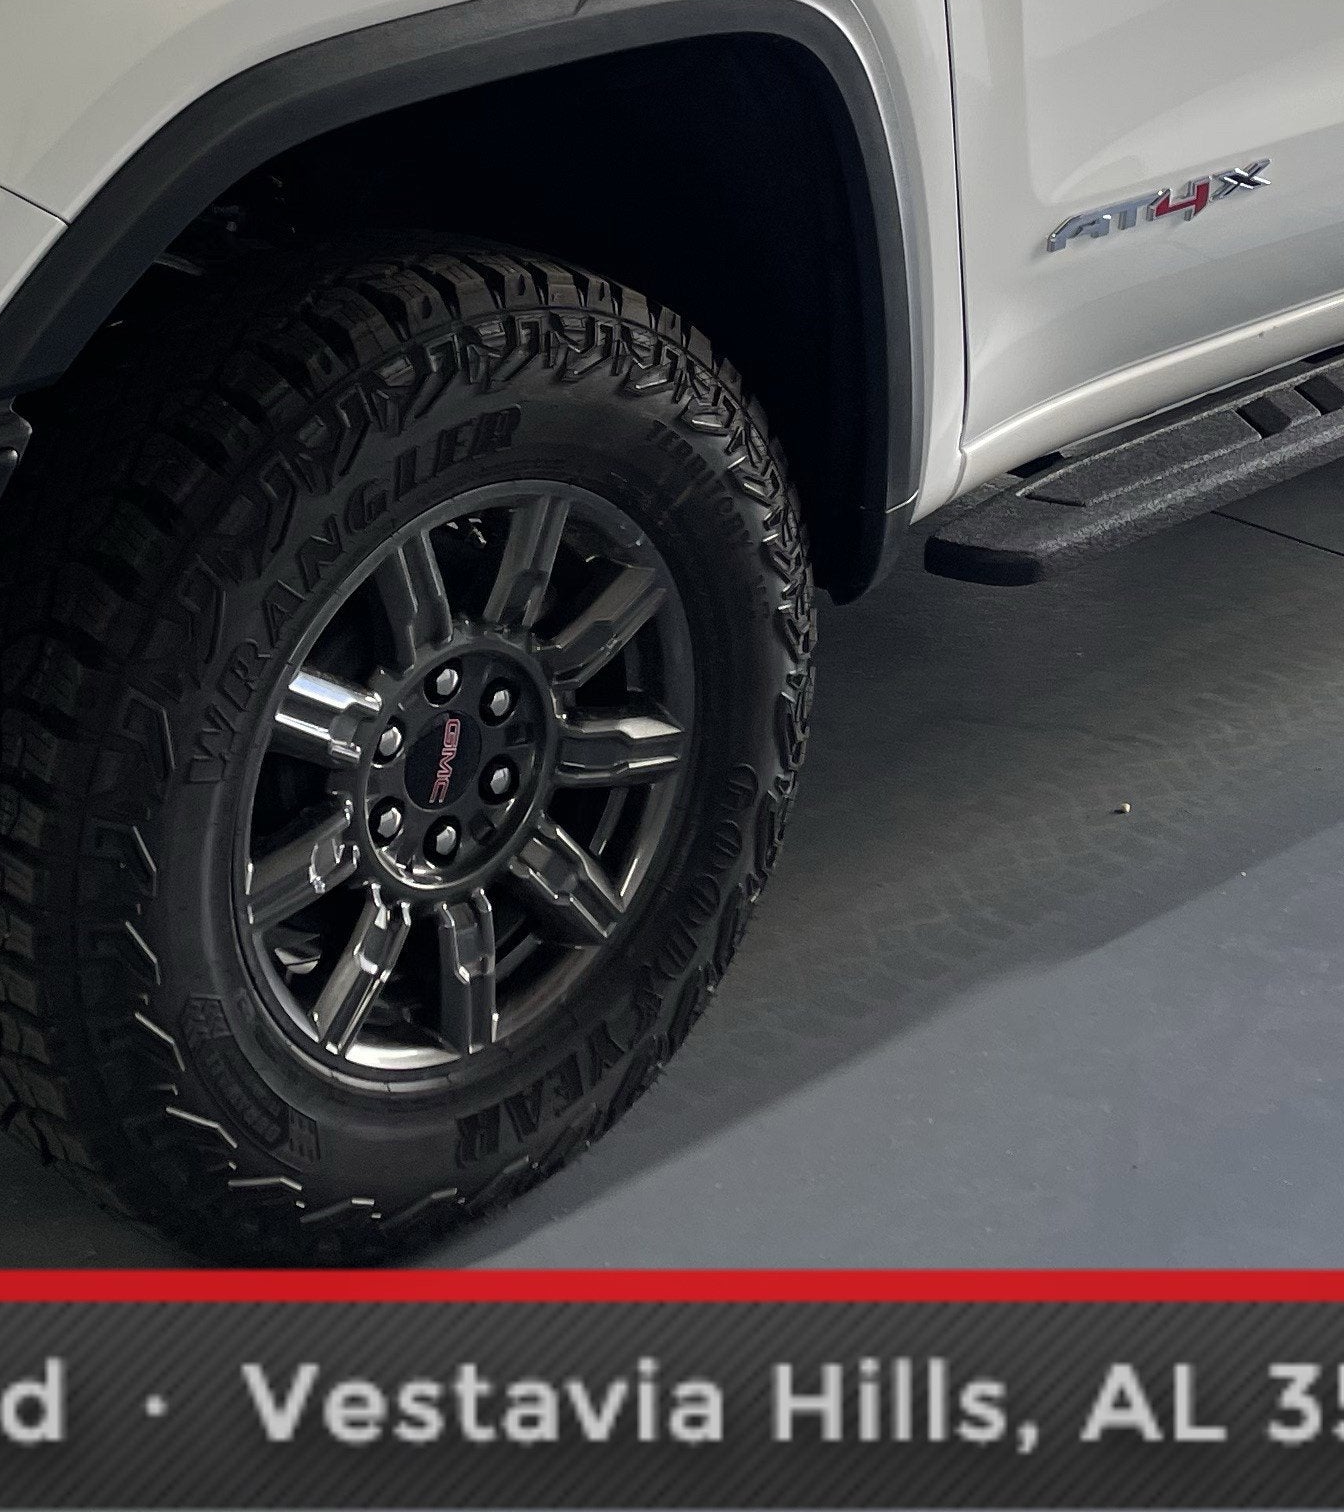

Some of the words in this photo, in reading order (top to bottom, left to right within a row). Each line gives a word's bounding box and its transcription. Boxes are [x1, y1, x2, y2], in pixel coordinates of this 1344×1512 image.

[1047, 158, 1272, 253] AT4X
[187, 402, 523, 786] WRANGLER
[428, 717, 461, 804] GMC
